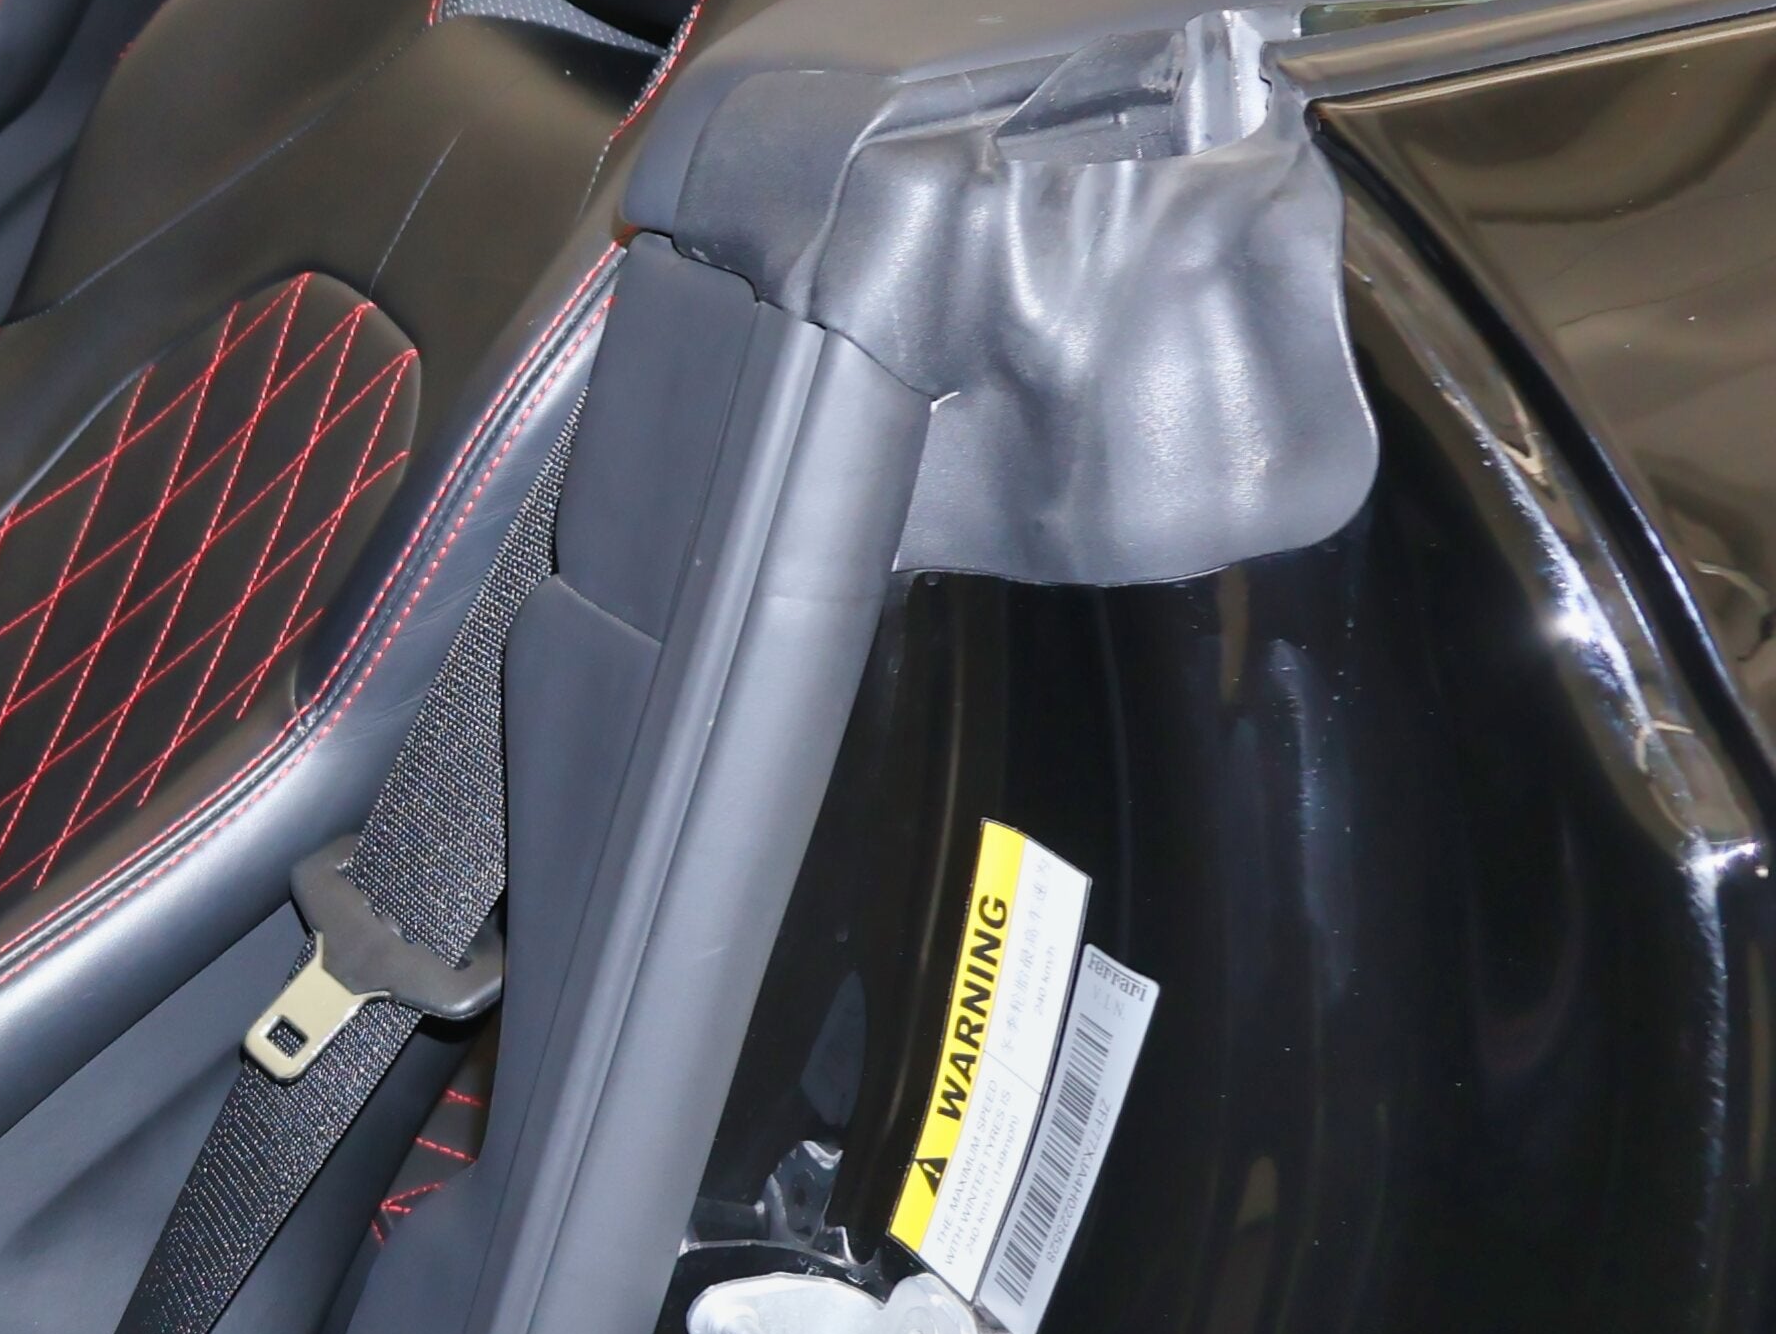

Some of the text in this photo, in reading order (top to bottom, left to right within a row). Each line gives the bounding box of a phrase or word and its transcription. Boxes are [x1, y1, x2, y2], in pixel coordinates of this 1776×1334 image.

[936, 889, 1009, 1127] WARNING
[1087, 951, 1149, 1003] Ferrari
[936, 1077, 998, 1246] THE MAXIMUM SPEED
[943, 1086, 1011, 1268] WITH WINTER TYRES IS
[963, 1224, 980, 1256] 240
[1044, 1096, 1113, 1265] ZFF77XJA4H0225528
